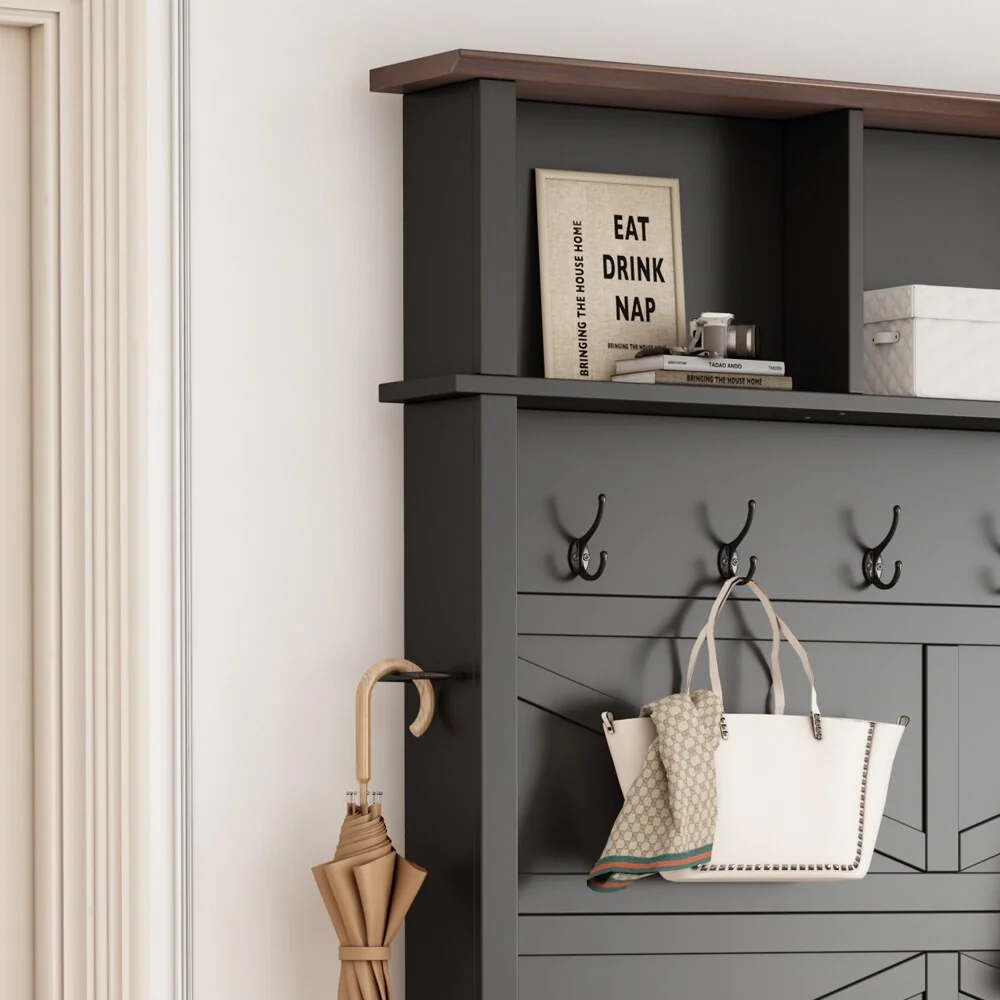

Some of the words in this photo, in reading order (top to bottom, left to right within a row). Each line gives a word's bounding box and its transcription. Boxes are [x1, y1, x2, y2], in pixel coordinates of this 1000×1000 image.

[572, 220, 583, 252] HOME
[613, 214, 650, 241] EAT
[574, 256, 585, 293] HOUSE
[602, 254, 666, 283] DRINK
[576, 296, 586, 318] THE
[615, 295, 656, 322] NAP
[577, 321, 589, 377] BRINGING
[607, 342, 629, 350] BRINGING
[629, 343, 639, 351] THE
[708, 361, 726, 369] TADAO
[727, 362, 742, 370] ANDO
[686, 374, 714, 384] BRINGING
[714, 375, 726, 384] THE
[727, 376, 746, 385] HOUSE
[747, 377, 763, 386] HOME
